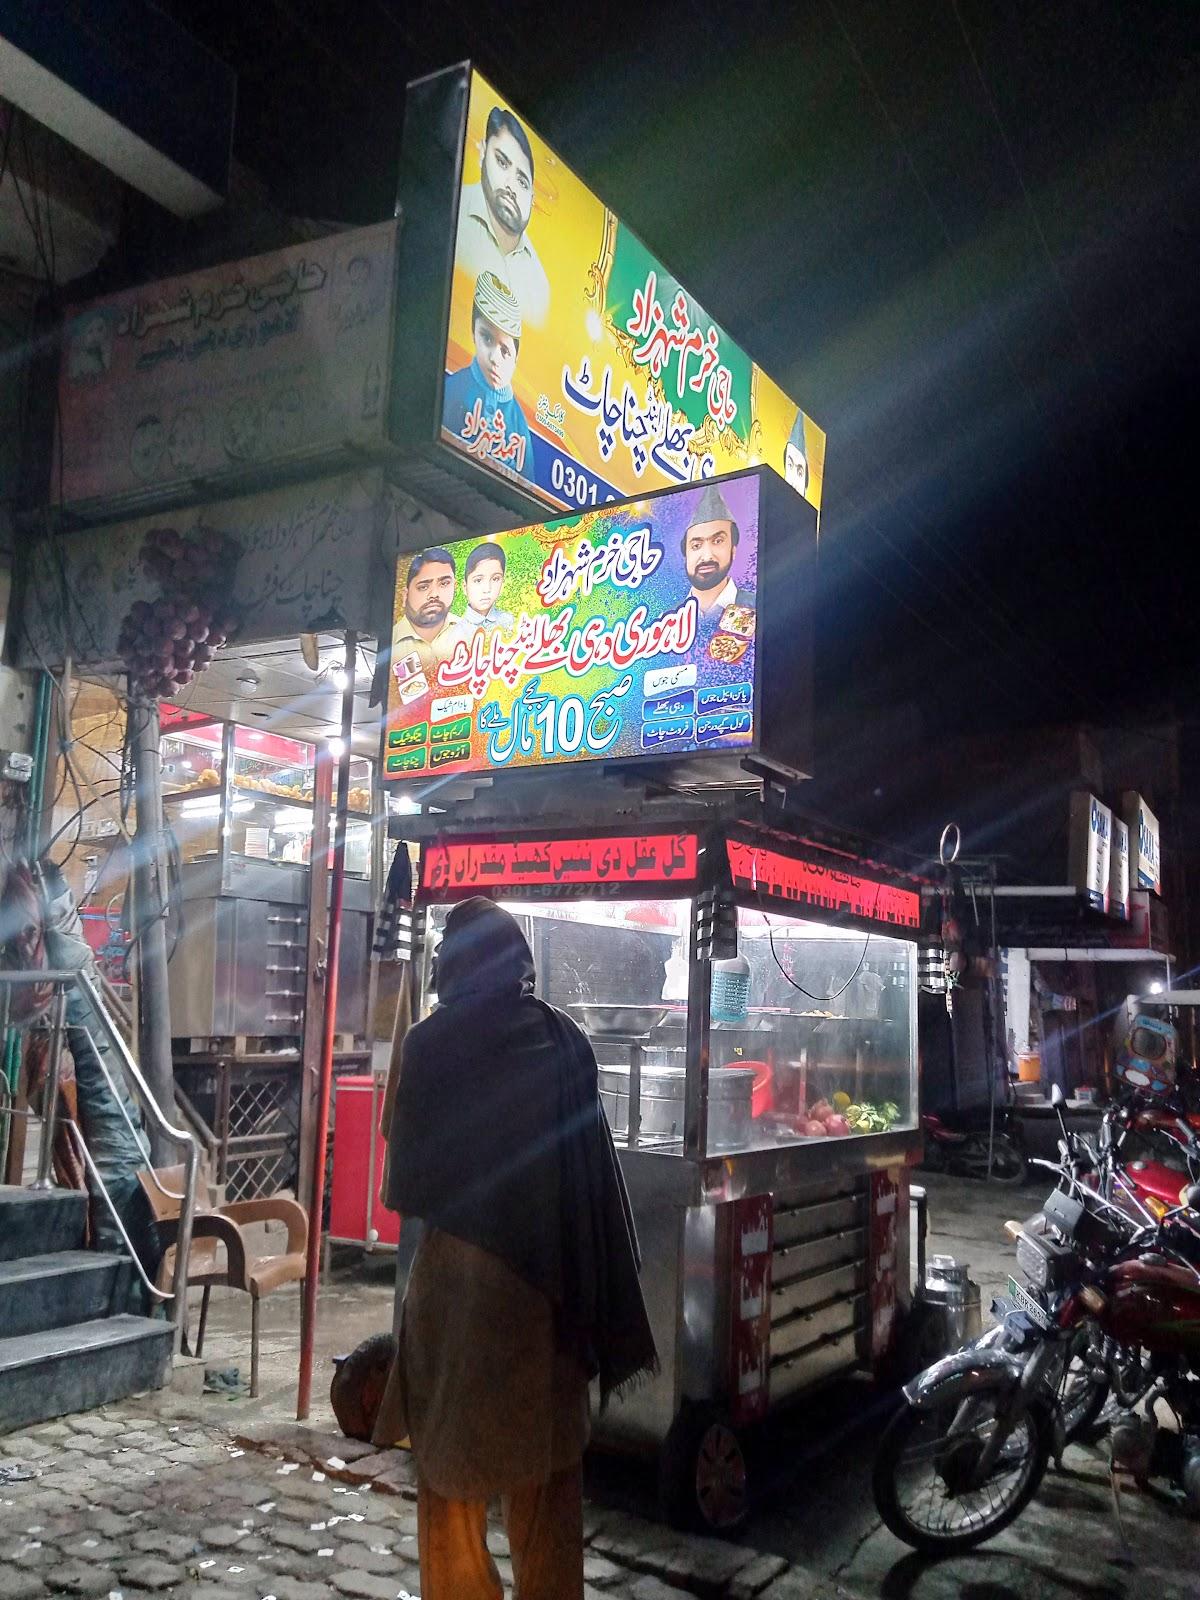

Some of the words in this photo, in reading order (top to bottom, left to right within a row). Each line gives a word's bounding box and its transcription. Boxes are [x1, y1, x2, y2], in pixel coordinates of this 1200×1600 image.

[628, 276, 690, 374] شہزاد
[678, 331, 718, 396] خرم
[708, 367, 737, 428] حاجی
[543, 542, 590, 599] شہزاد
[586, 537, 620, 591] خرم
[615, 530, 657, 585] حاجی
[524, 612, 570, 670] بھلے
[570, 620, 612, 672] دہی
[616, 600, 696, 665] لاہوری
[536, 697, 585, 754] 10
[586, 674, 633, 750] صبح
